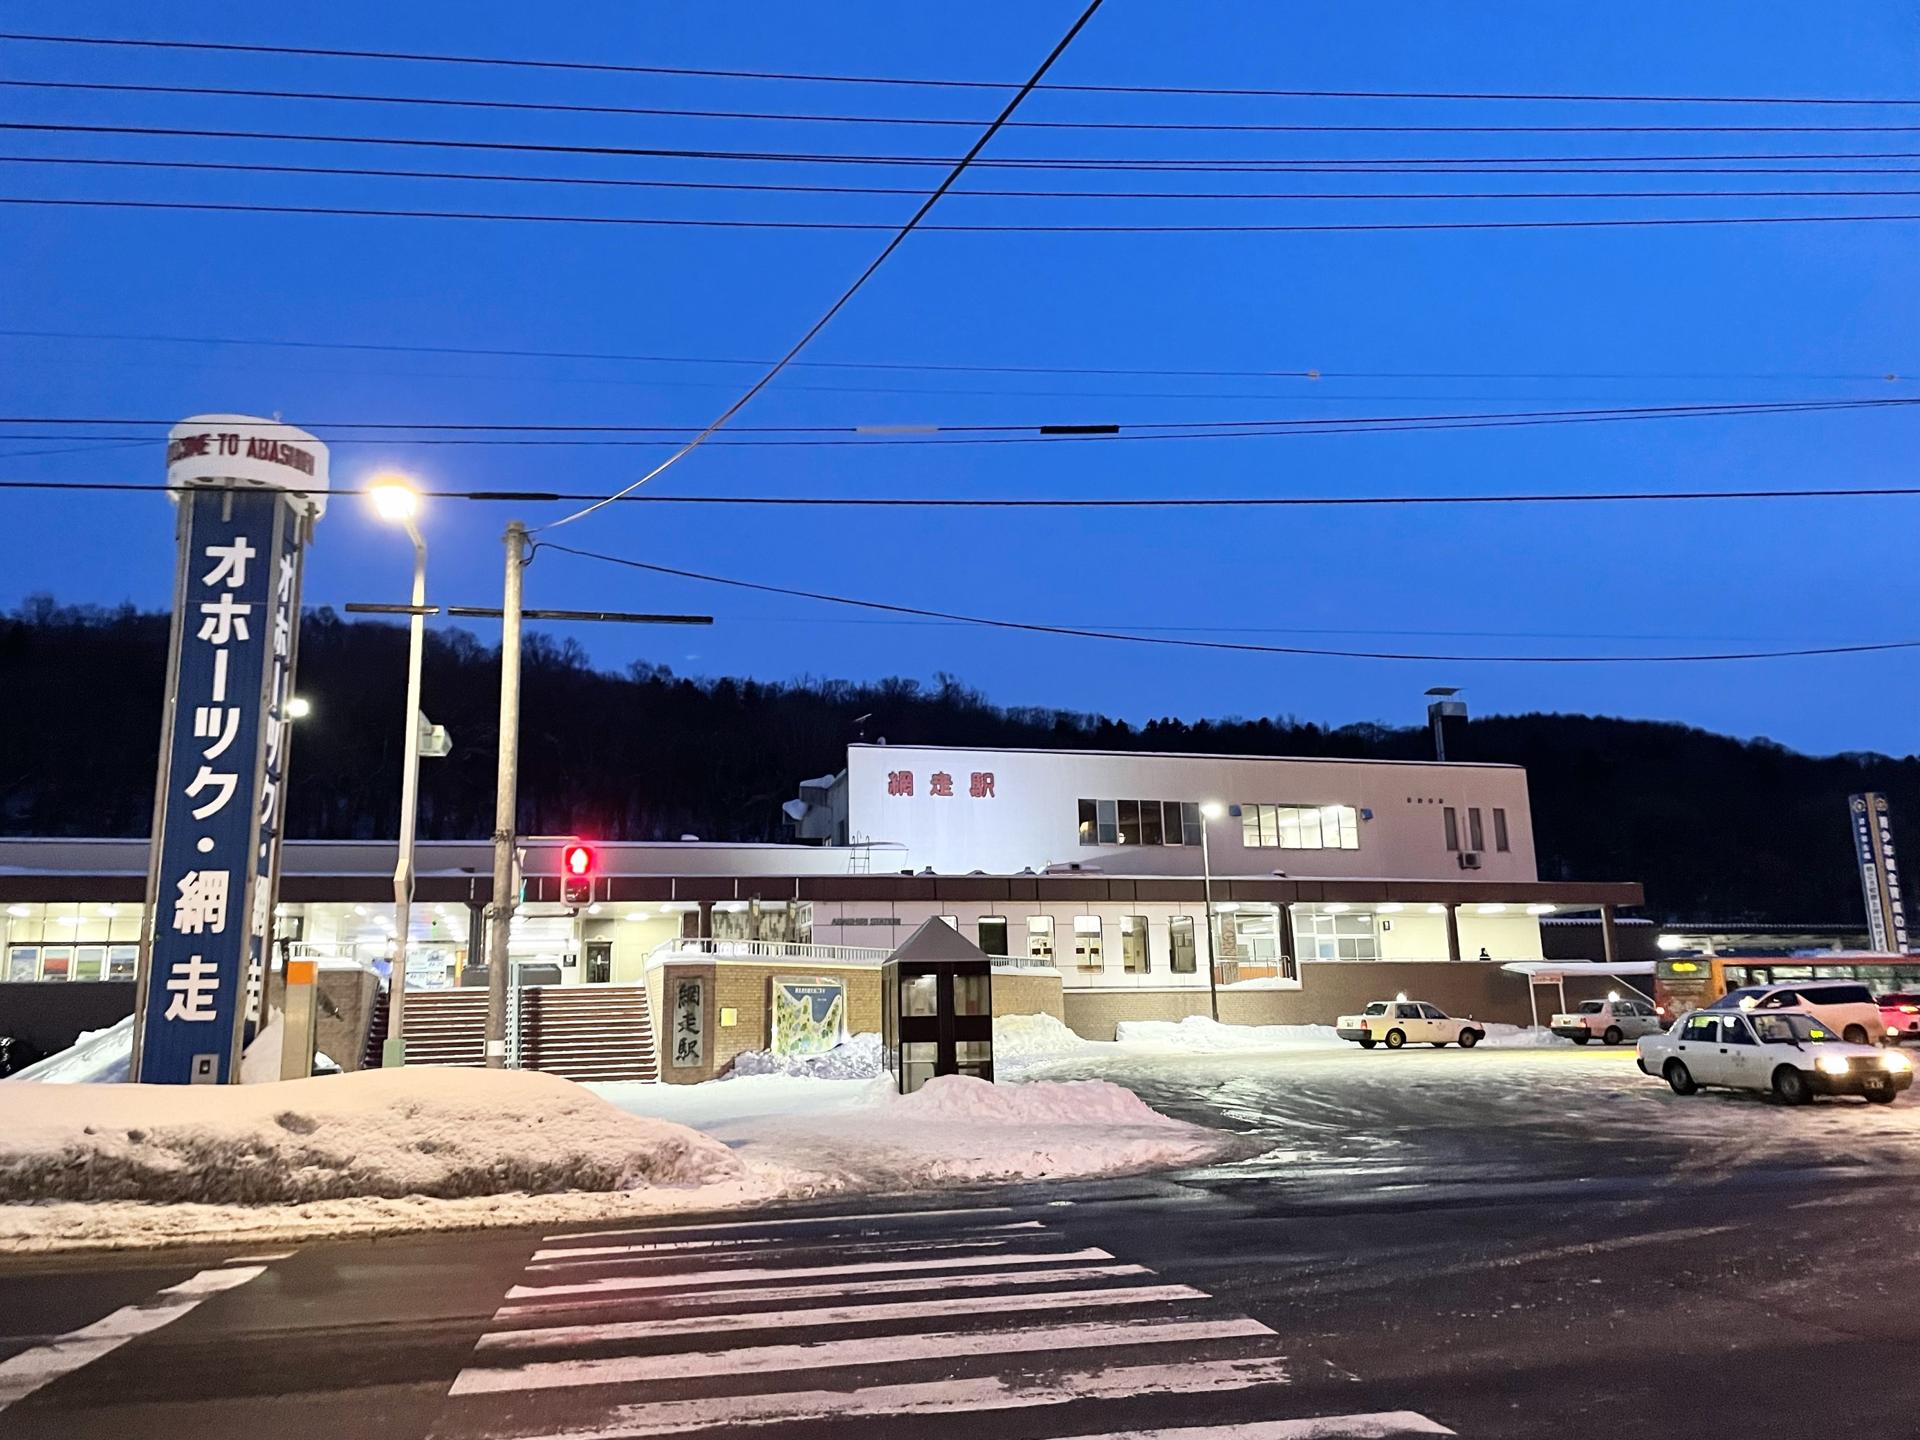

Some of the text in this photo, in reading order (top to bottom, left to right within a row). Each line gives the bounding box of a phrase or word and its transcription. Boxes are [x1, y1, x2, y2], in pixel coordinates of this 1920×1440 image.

[217, 433, 240, 456] TO
[163, 536, 256, 1022] オホーツク・網走
[888, 770, 995, 798] 網走駅
[675, 984, 701, 1062] 網走駅
